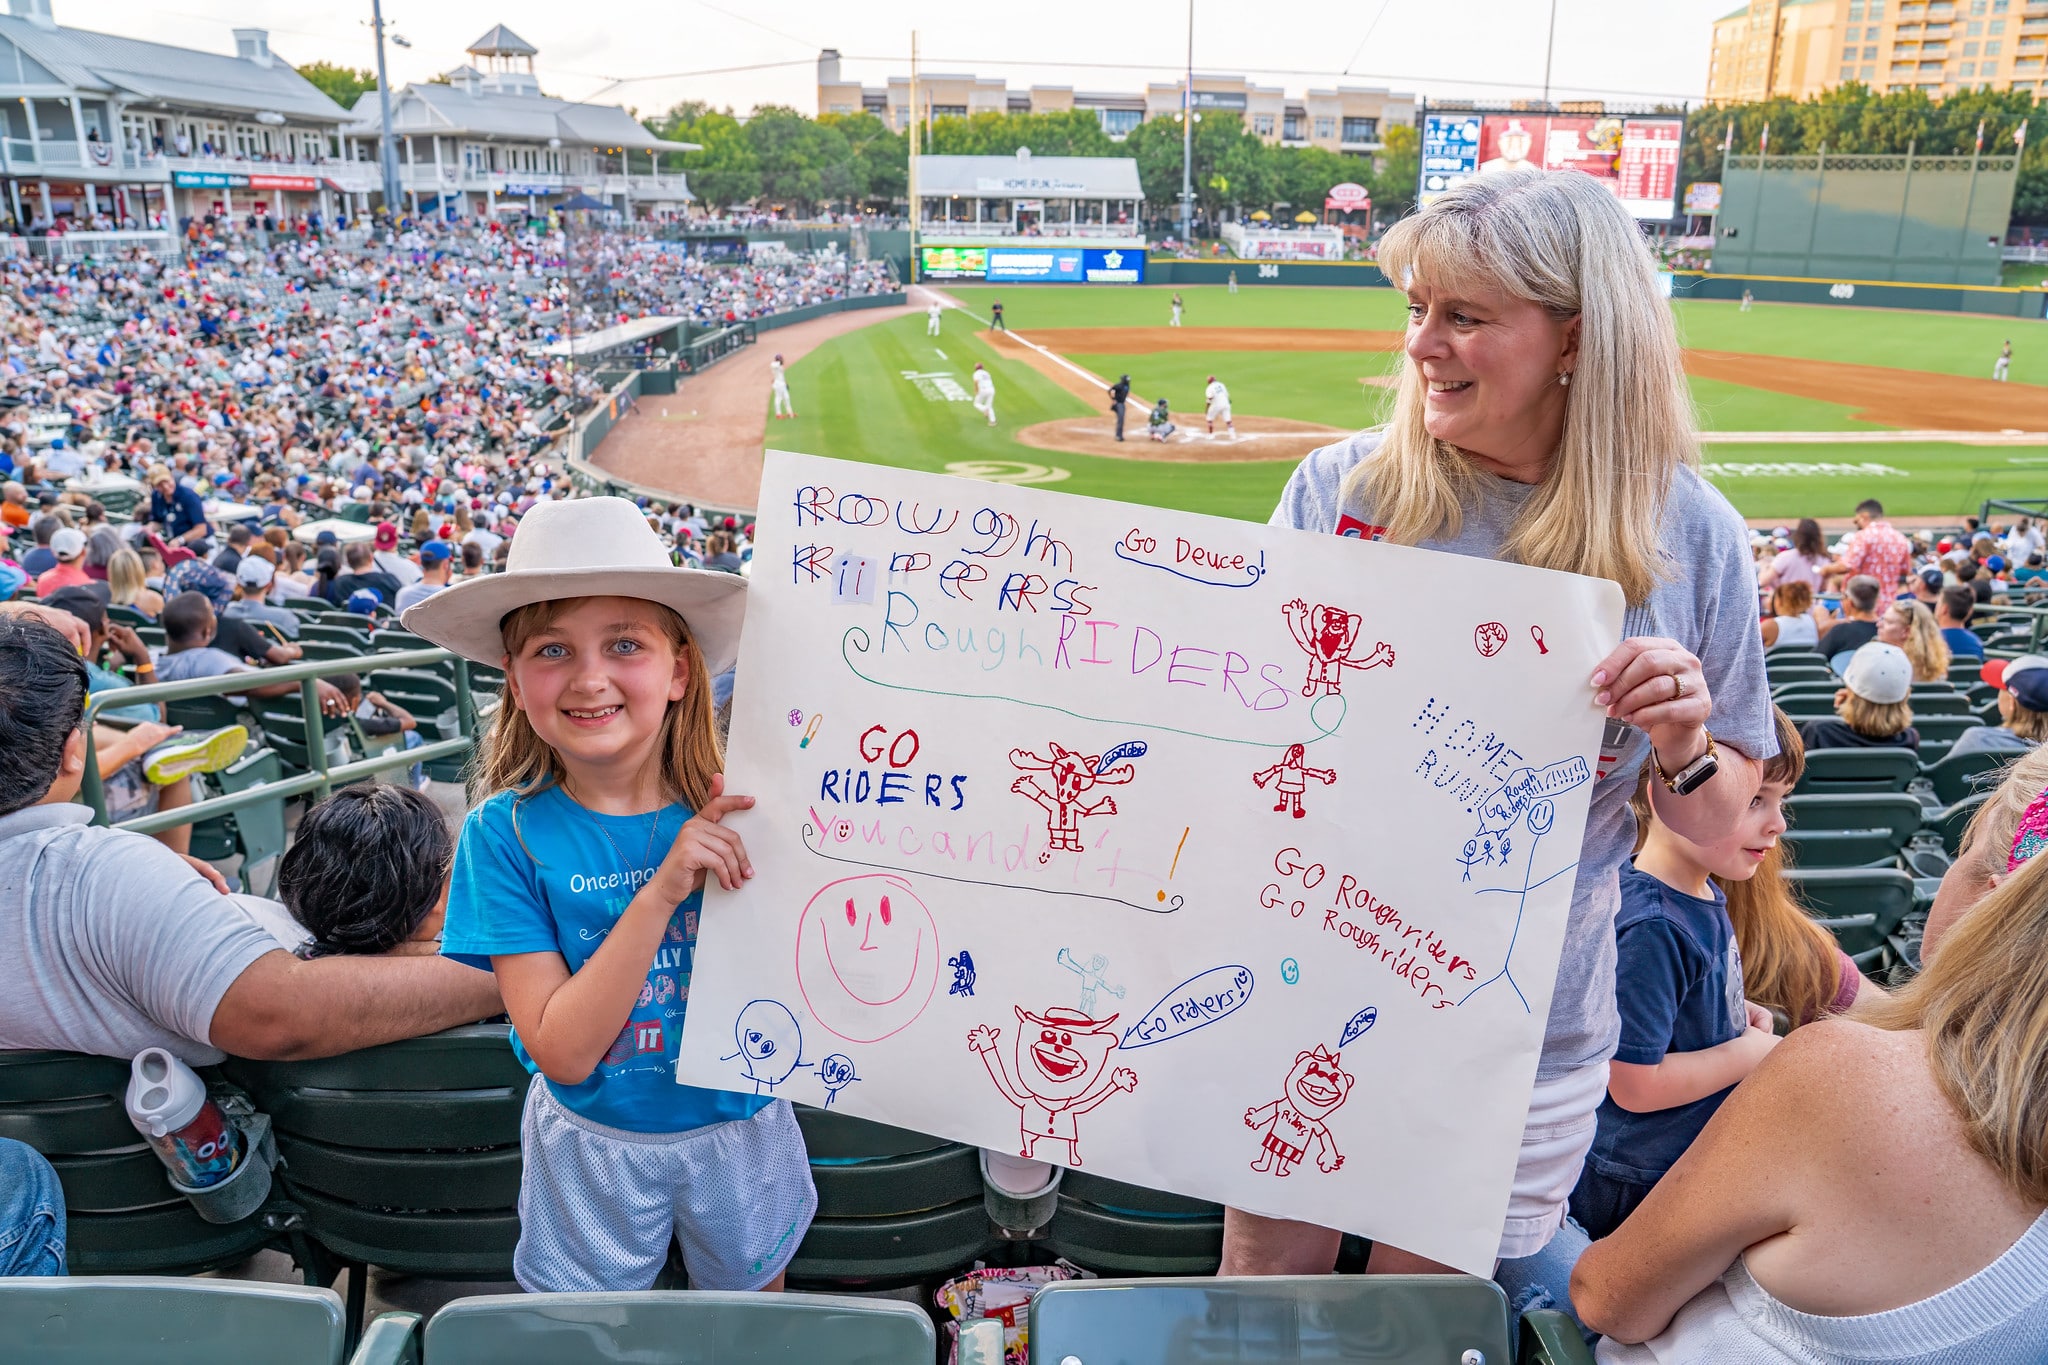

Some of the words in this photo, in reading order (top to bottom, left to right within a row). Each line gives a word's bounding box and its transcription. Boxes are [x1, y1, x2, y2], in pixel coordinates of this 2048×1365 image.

[1258, 264, 1279, 278] 364
[860, 725, 919, 768] GO
[1412, 697, 1524, 782] HOME
[638, 1028, 661, 1050] IT
